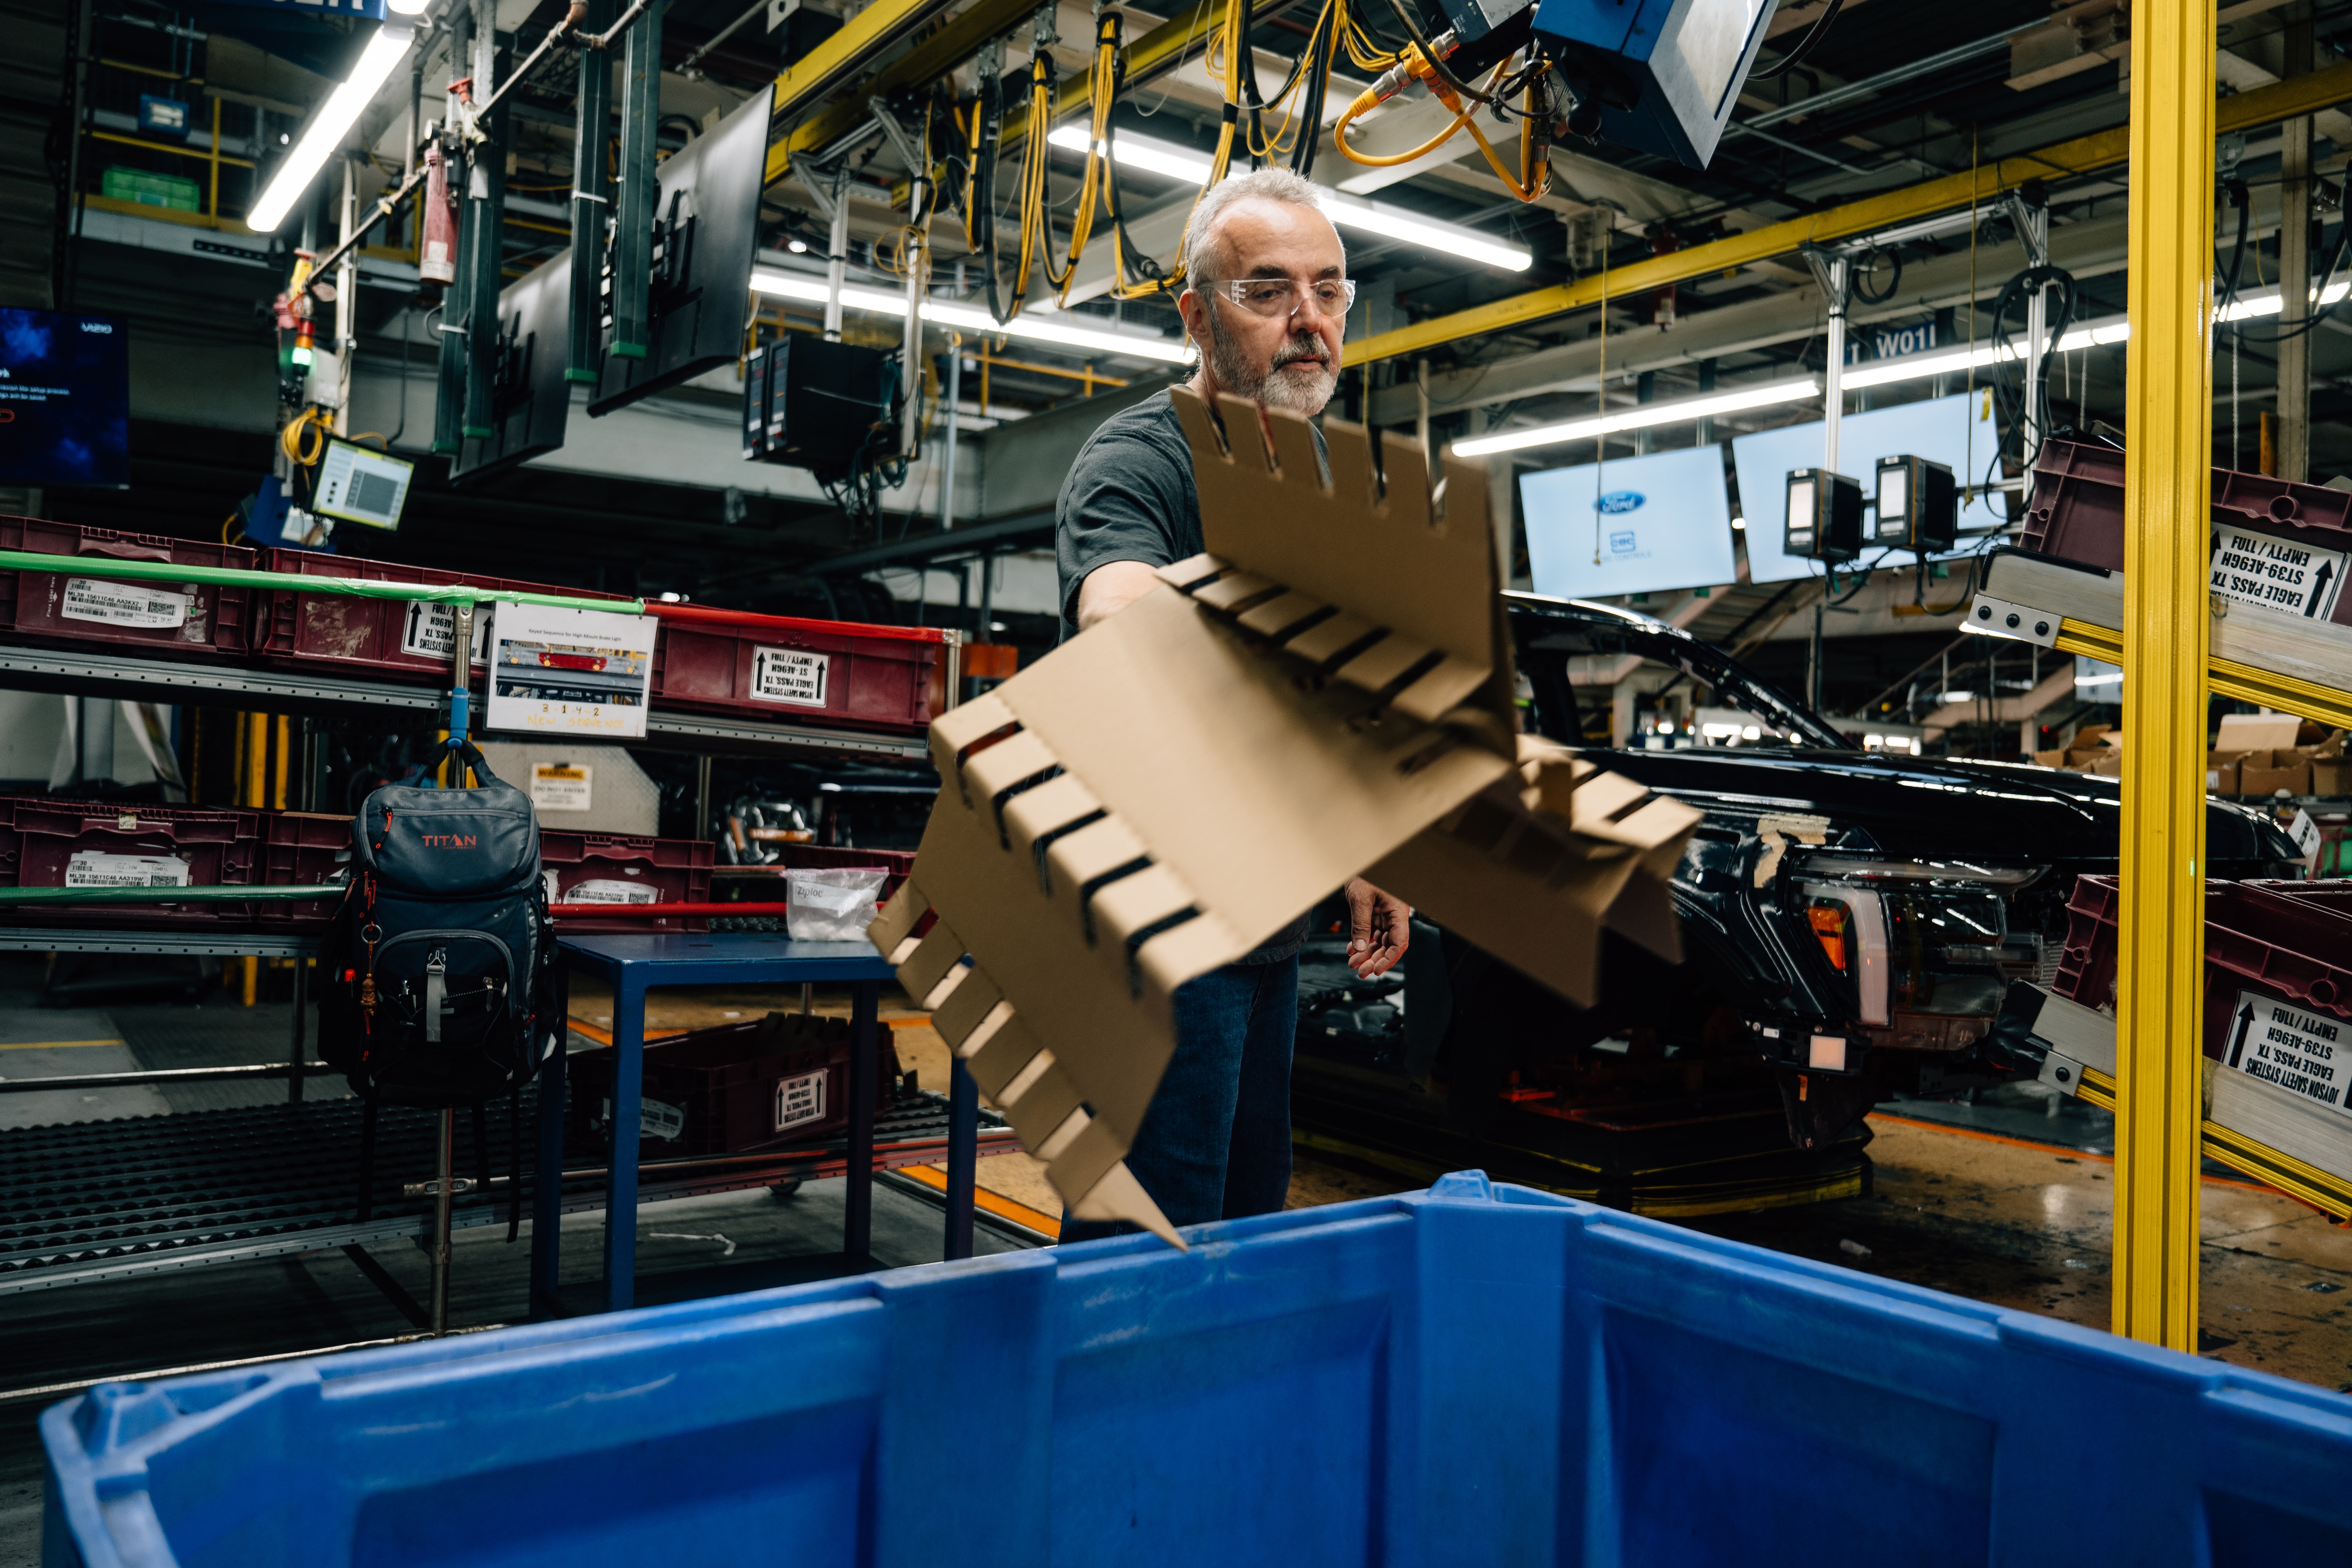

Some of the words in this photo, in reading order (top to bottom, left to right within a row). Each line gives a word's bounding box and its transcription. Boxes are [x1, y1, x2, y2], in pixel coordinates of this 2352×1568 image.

[1452, 18, 1462, 34] OUTPUT
[2231, 535, 2257, 552] FULL
[2266, 544, 2311, 567] EMPTY
[2220, 551, 2304, 585] ST39-AE9GH
[2211, 571, 2227, 588] TX
[2231, 574, 2265, 597] PASS,
[2264, 585, 2303, 607] EAGLE
[432, 604, 446, 615] FULL
[425, 628, 433, 637] TX
[435, 629, 453, 641] PASS,
[420, 638, 442, 652] SYSTEMS
[771, 653, 785, 661] FULL
[792, 656, 813, 666] EMPTY
[776, 677, 794, 687] PASS,
[796, 679, 814, 689] EAGLE
[763, 686, 783, 696] SYSTEMS
[784, 688, 799, 697] SAFETY
[799, 690, 814, 700] JOYSON
[422, 834, 476, 846] TITAN
[797, 886, 823, 898] Ziploc
[2272, 1007, 2295, 1027] FULL
[2301, 1018, 2338, 1042] EMPTY
[2257, 1043, 2270, 1059] TX
[2267, 1027, 2333, 1059] ST39-AE9GH
[2273, 1047, 2302, 1070] PASS,
[2245, 1057, 2281, 1083] SYSTEMS
[2302, 1059, 2334, 1081] EAGLE
[2280, 1070, 2309, 1094] SAFETY
[2307, 1079, 2340, 1105] JOYSON
